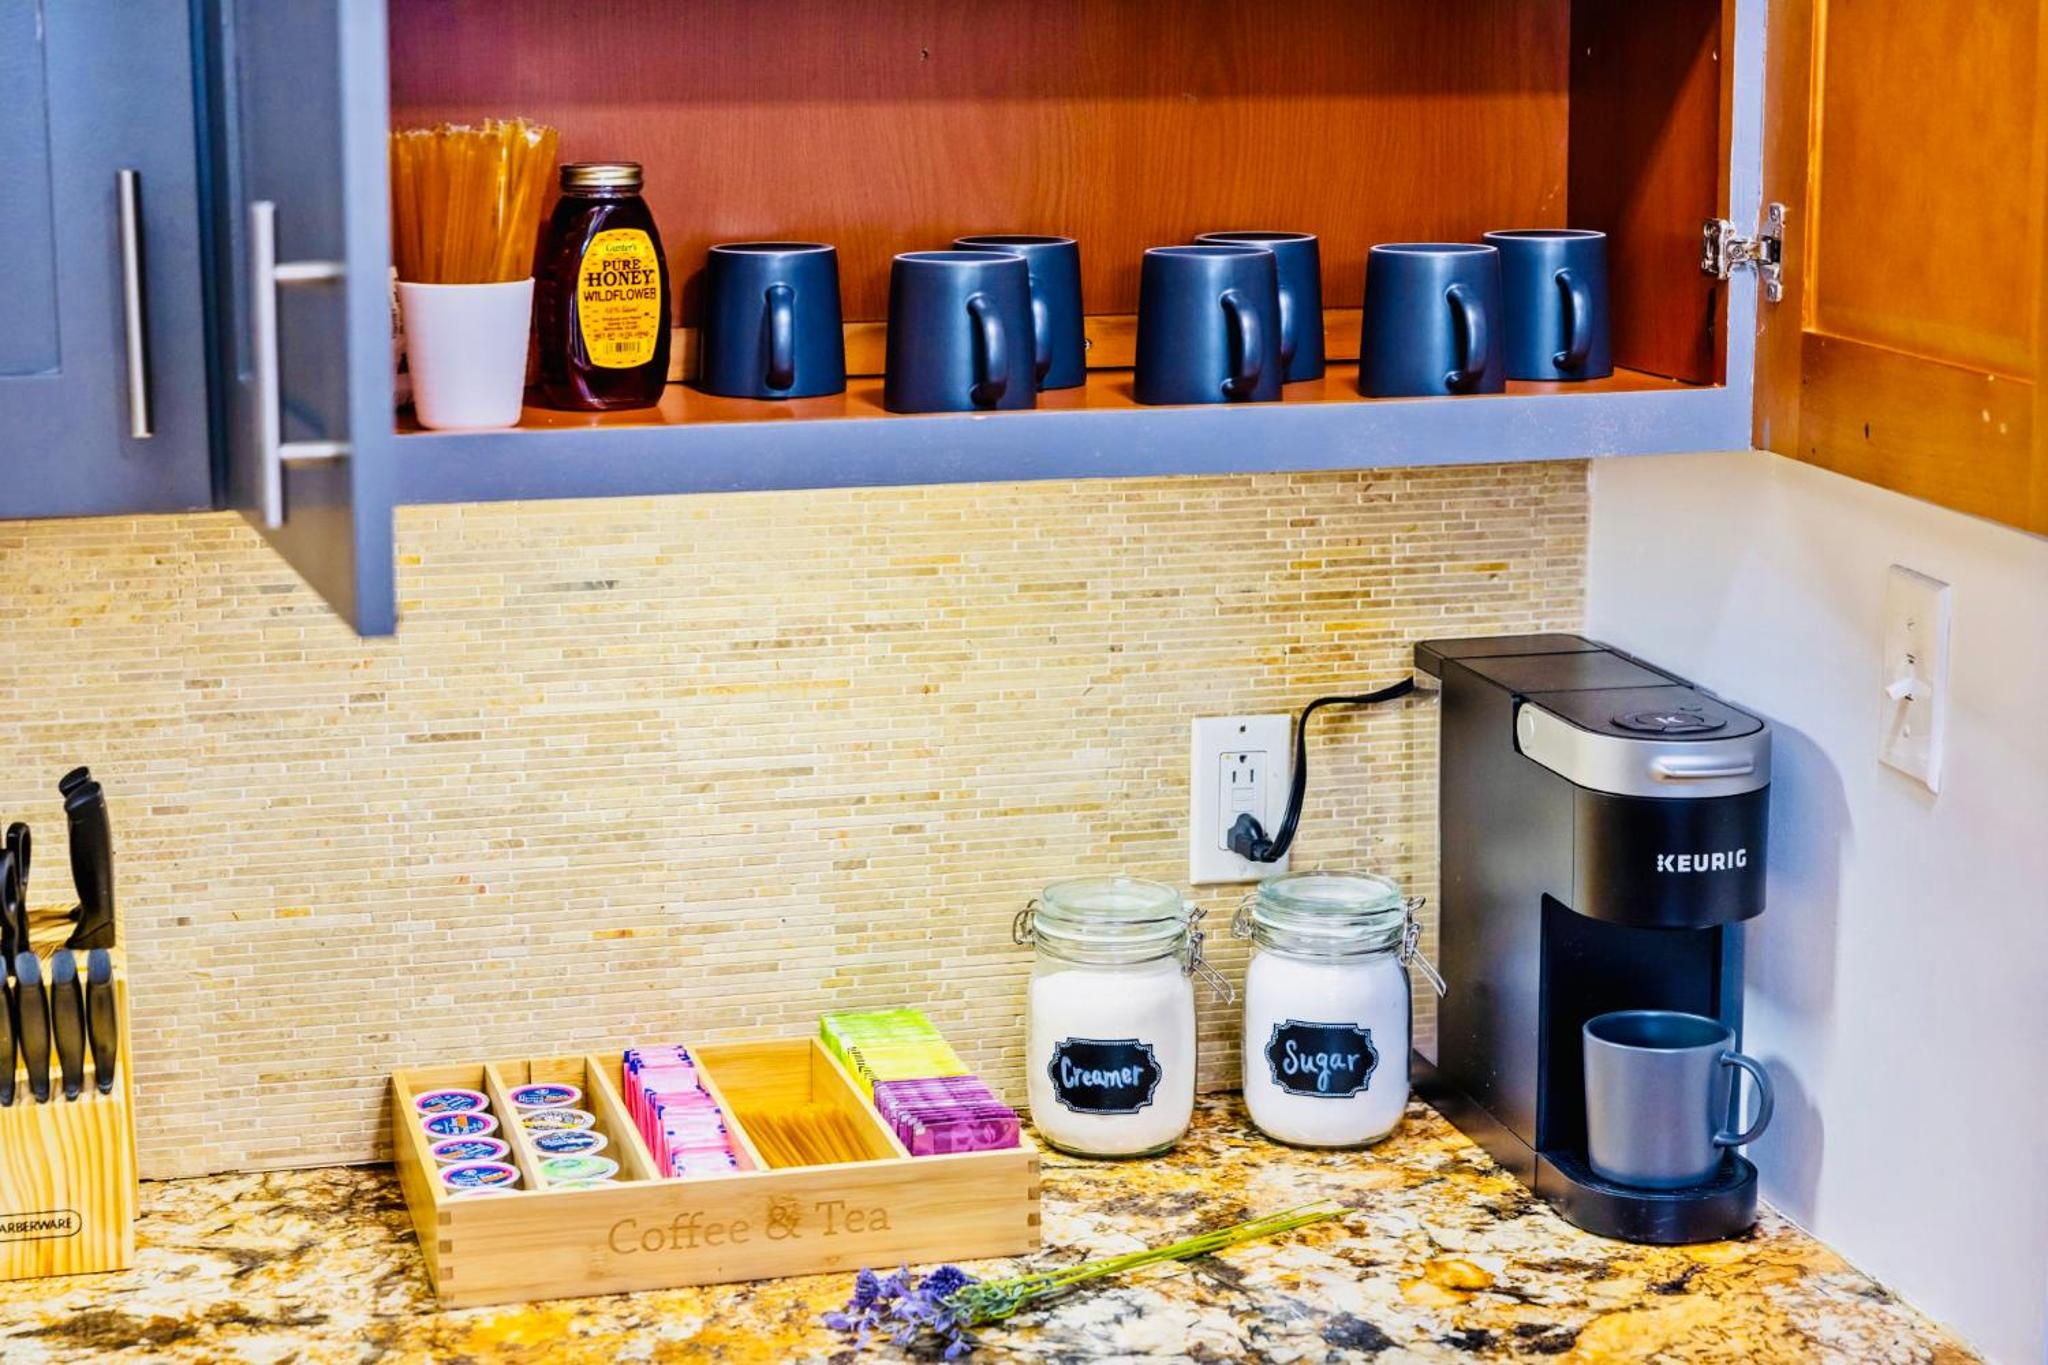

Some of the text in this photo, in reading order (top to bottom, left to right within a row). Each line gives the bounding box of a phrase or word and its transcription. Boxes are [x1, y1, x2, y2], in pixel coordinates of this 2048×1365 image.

[602, 258, 641, 271] PURE
[587, 269, 655, 287] HONEY
[583, 287, 656, 302] WILDFLOWER
[1656, 848, 1747, 873] KEURIG
[1060, 1055, 1144, 1089] Creamer
[1282, 1040, 1360, 1090] Sugar
[607, 1200, 892, 1255] Coffee & Tea
